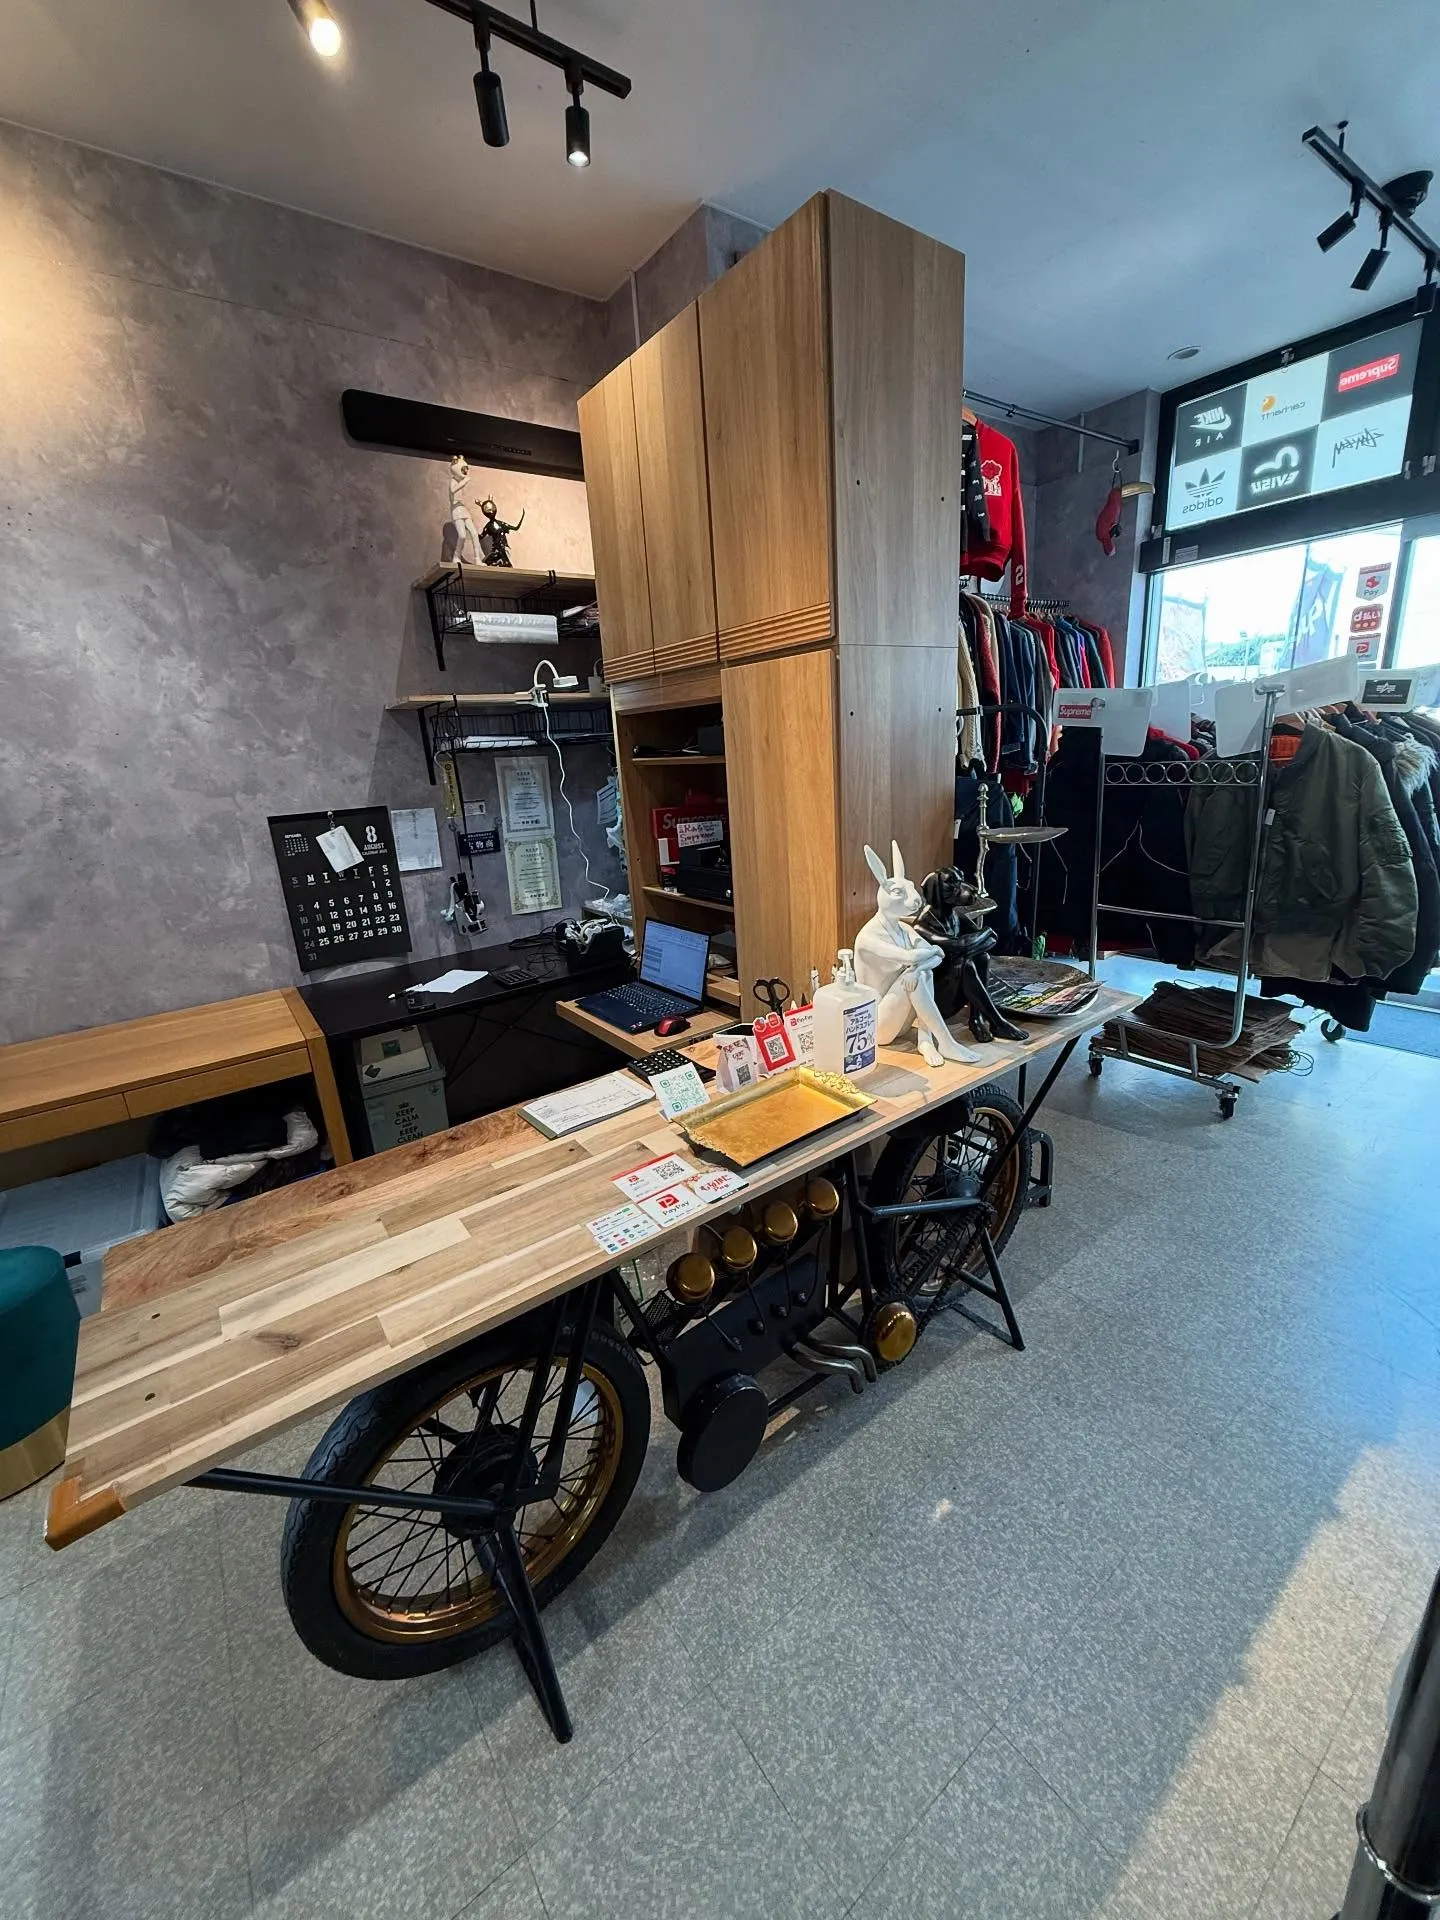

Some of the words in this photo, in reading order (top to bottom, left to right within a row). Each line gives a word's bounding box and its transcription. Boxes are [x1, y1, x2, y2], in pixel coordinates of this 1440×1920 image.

[1364, 589, 1378, 597] Pay
[1060, 706, 1091, 716] Supreme
[365, 825, 378, 843] 8
[364, 843, 384, 851] AUGUST
[307, 874, 314, 882] M
[368, 866, 374, 874] F
[329, 899, 335, 907] 5
[330, 911, 338, 919] 12
[345, 909, 353, 917] 13
[359, 907, 368, 915] 14
[374, 904, 383, 912] 15
[388, 902, 396, 910] 16
[317, 926, 326, 934] 18
[332, 923, 341, 931] 19
[346, 921, 357, 929] 20
[362, 918, 371, 926] 21
[375, 916, 386, 924] 22
[390, 914, 400, 922] 23
[319, 938, 330, 946] 25
[334, 935, 344, 943] 26
[348, 932, 359, 940] 27
[363, 930, 373, 938] 28
[377, 928, 388, 936] 29
[392, 925, 402, 933] 30
[850, 1013, 872, 1025] アルコール
[846, 1020, 874, 1033] ハンドスプレー
[846, 1027, 874, 1053] 75%
[396, 1107, 415, 1117] KEEP
[395, 1114, 419, 1125] CALM
[397, 1131, 423, 1143] CLEAN
[400, 1126, 418, 1136] KEEP
[662, 1200, 689, 1215] PayPay
